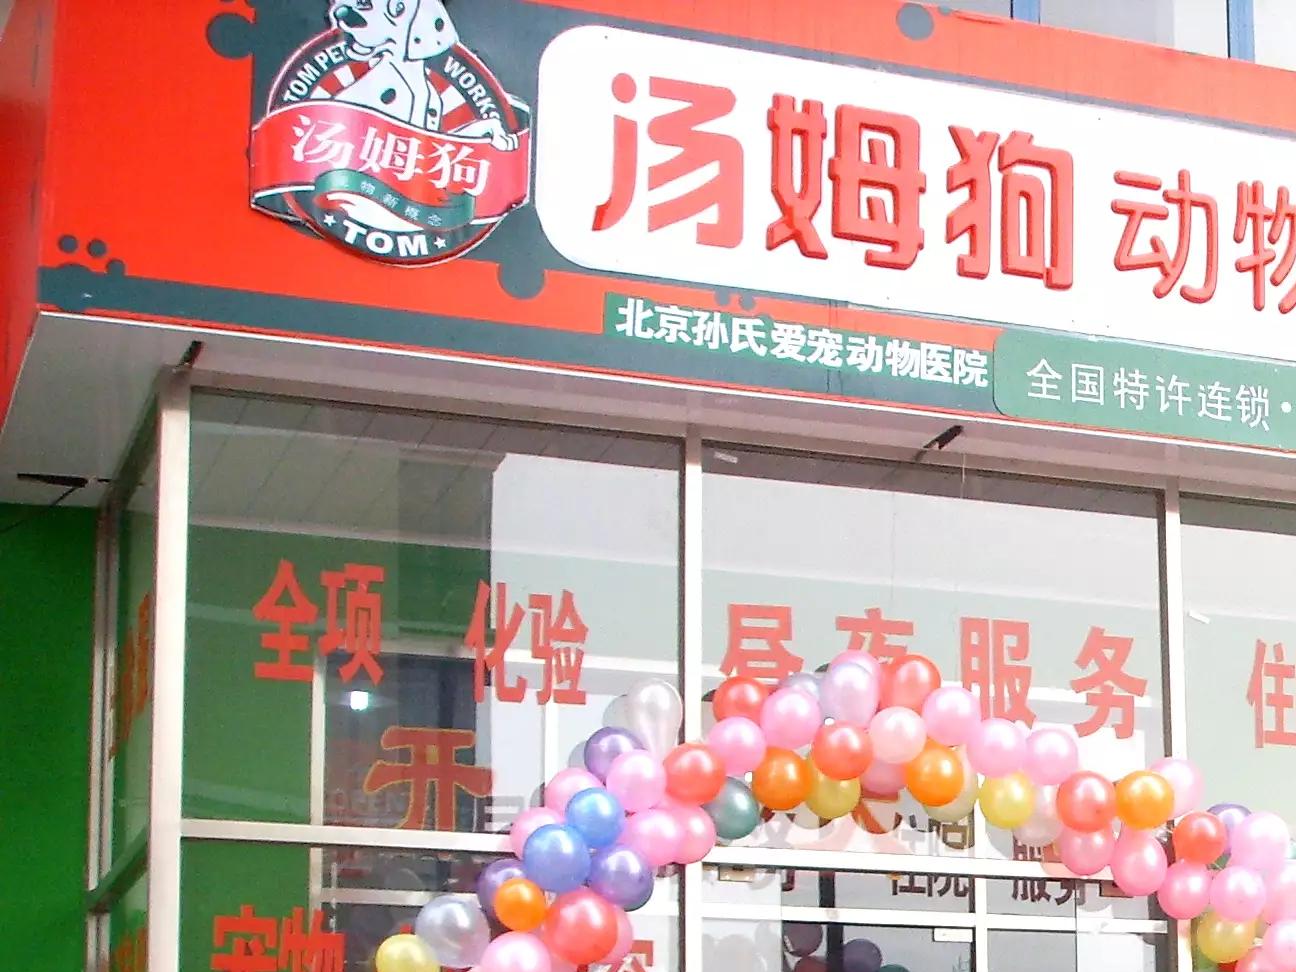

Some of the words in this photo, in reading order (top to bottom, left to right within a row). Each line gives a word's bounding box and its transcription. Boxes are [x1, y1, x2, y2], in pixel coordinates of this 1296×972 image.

[291, 114, 490, 196] 汤姆狗
[343, 219, 429, 257] TOM
[615, 297, 989, 388] 北京孙氏爱宠动物医院
[253, 559, 386, 684] 全项
[465, 579, 589, 706] 化验
